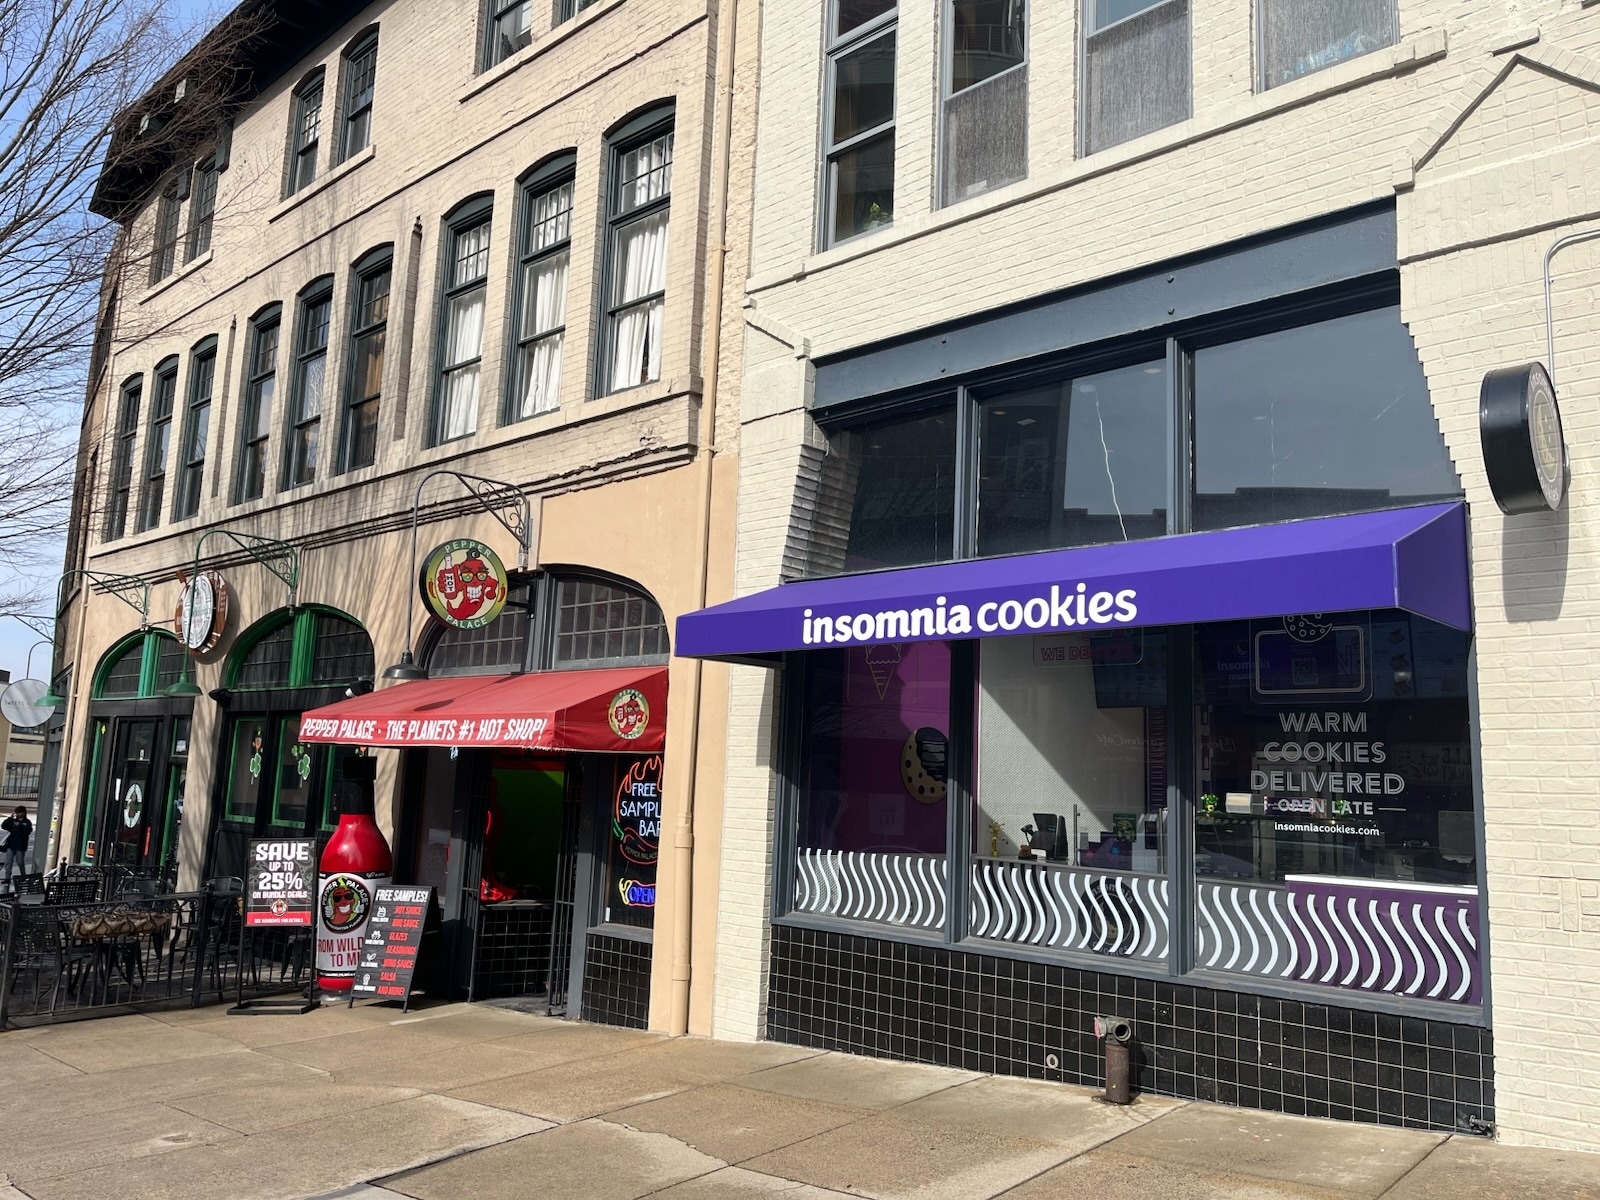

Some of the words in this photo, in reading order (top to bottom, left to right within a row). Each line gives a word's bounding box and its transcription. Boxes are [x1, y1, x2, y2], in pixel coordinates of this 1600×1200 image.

[445, 540, 491, 557] PEPPER
[446, 575, 454, 592] HOT
[801, 596, 972, 644] insomnia
[977, 582, 1138, 633] cookies
[446, 614, 488, 629] PALACE
[1041, 647, 1065, 661] WE
[1216, 660, 1270, 672] insomia
[300, 718, 339, 738] PEPPER
[337, 719, 377, 740] PALACE
[385, 720, 408, 740] THE
[406, 719, 458, 741] PLANETS
[458, 719, 476, 741] #1
[476, 719, 506, 741] HOT
[503, 718, 548, 741] SHOP!
[1279, 712, 1367, 733] WARM
[1263, 741, 1387, 764] COOKIES
[631, 783, 657, 797] FREE
[1251, 770, 1405, 795] DELIVERED
[620, 801, 662, 818] SAMPL
[1277, 799, 1325, 813] OPEN
[1331, 801, 1374, 815] LATE
[1274, 822, 1380, 836] insomniacookies.com
[255, 842, 310, 861] SAVE
[269, 861, 281, 871] UP
[282, 861, 294, 871] TO
[258, 872, 303, 890] 25%
[252, 891, 261, 899] ON
[262, 891, 286, 899] BUNDLE
[287, 890, 308, 898] DEALS
[322, 880, 338, 906] PEPPER
[345, 880, 369, 906] PALACE
[375, 889, 393, 902] FREE
[392, 889, 429, 903] SAMPLES!
[629, 886, 655, 903] OPEN
[389, 932, 409, 941] GLAZES
[318, 938, 334, 953] ROM
[336, 937, 364, 952] WILD
[330, 953, 344, 967] TO
[380, 971, 397, 981] SALSA
